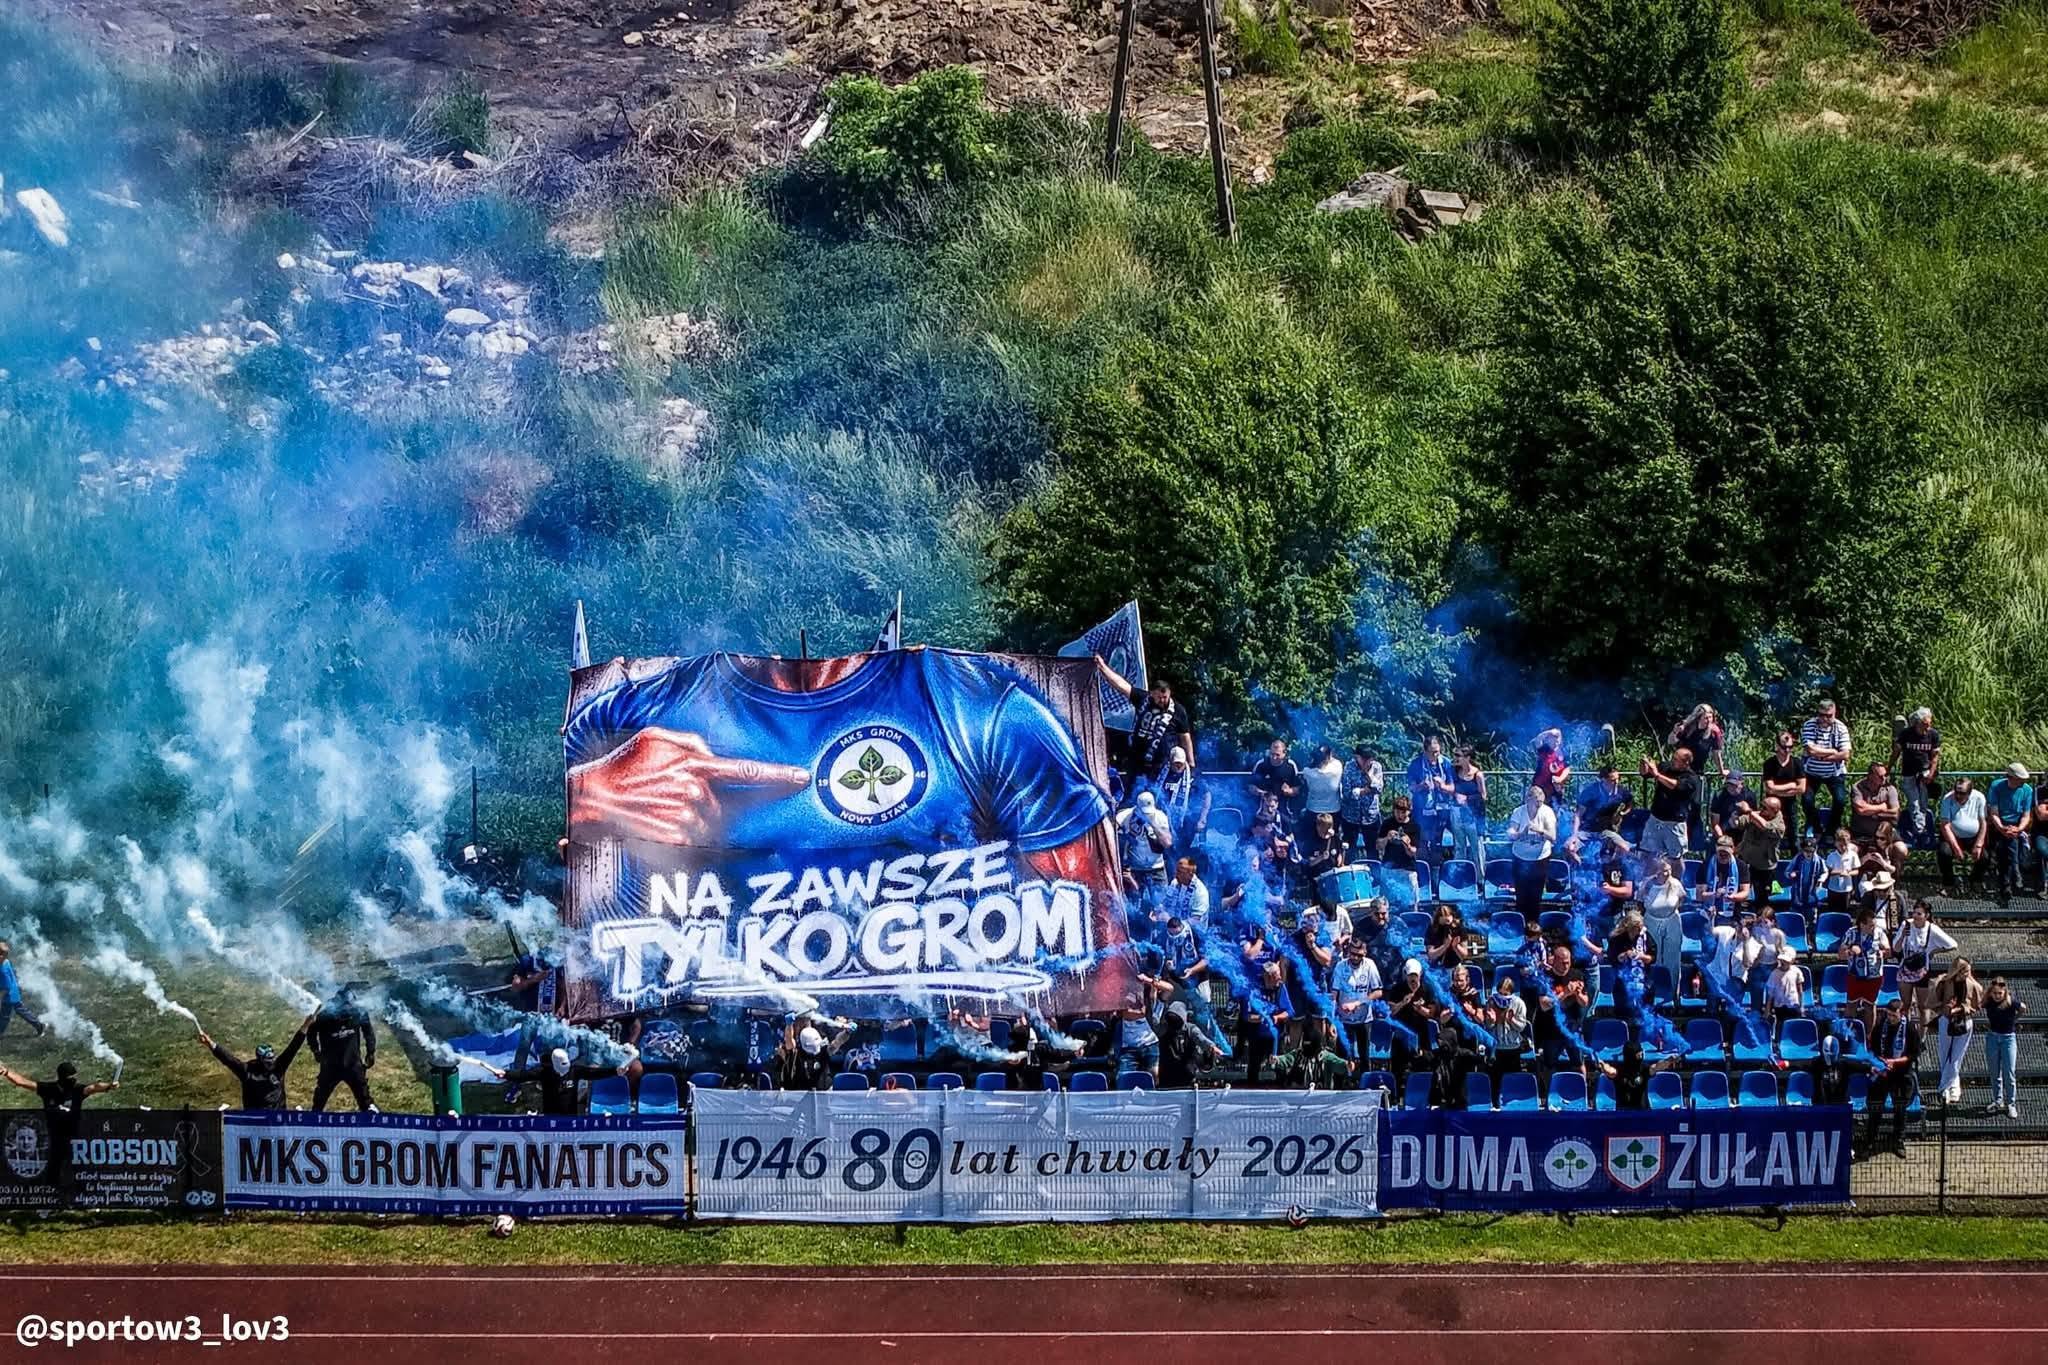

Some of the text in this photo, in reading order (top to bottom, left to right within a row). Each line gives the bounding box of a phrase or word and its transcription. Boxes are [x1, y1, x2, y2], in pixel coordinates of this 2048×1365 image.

[839, 728, 903, 747] MKS GROM
[817, 778, 828, 787] 19
[839, 802, 909, 825] NOWY STAW
[650, 842, 1012, 916] NA ZAWSZE
[596, 882, 1090, 992] TYLKO GROM
[276, 1114, 303, 1123] NIC
[318, 1115, 356, 1124] TEGO
[70, 1139, 178, 1165] ROBSON
[238, 1136, 671, 1190] MKS GROM FANATICS
[712, 1127, 1365, 1191] 1946 80 lat chwały 2026
[1390, 1122, 1841, 1192] DUMA ŻUŁAW
